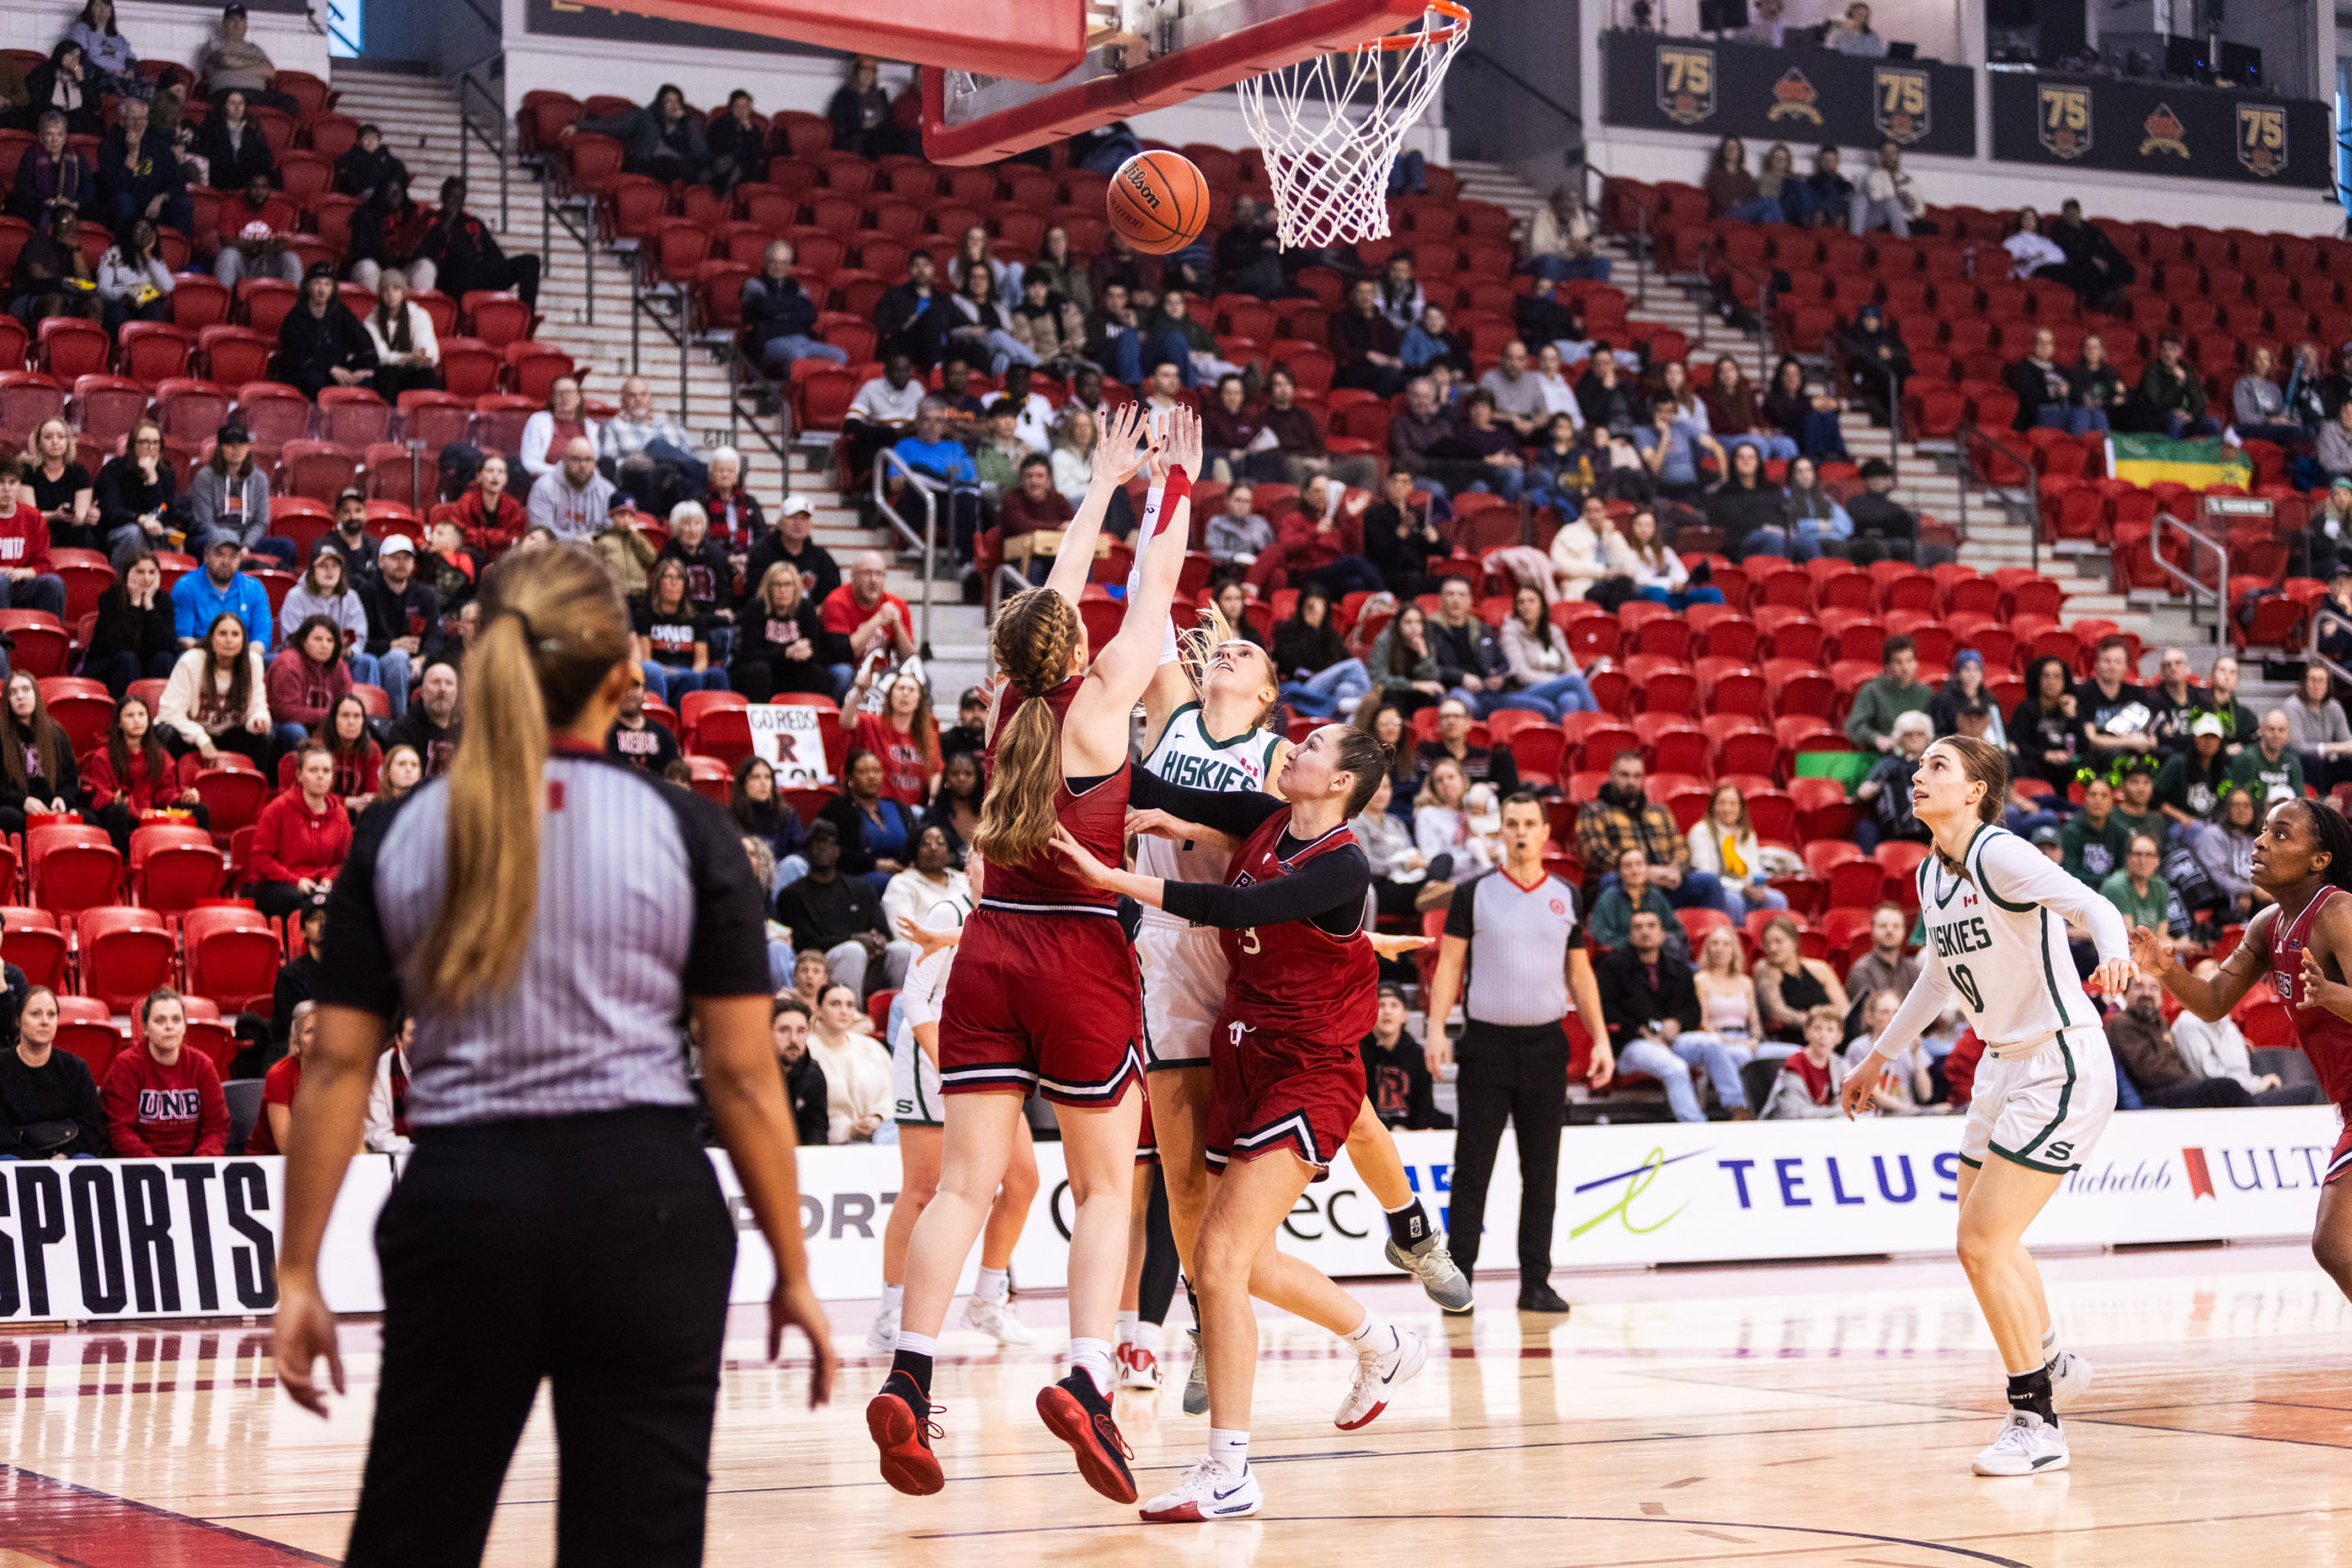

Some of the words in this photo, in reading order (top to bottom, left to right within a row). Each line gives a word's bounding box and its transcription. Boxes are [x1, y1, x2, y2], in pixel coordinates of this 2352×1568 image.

[1661, 52, 1710, 95] 75
[1878, 73, 1924, 115] 75
[2041, 90, 2086, 130] 75
[2240, 109, 2283, 149] 75
[750, 709, 774, 729] GO
[616, 729, 660, 755] REDS
[775, 734, 798, 763] R
[1947, 964, 1984, 1013] 10
[139, 1089, 200, 1120] UNB
[896, 1099, 913, 1114] S
[1377, 1066, 1411, 1110] R
[2044, 1141, 2075, 1161] S
[2221, 1145, 2335, 1190] ULT
[1717, 1152, 1958, 1209] TELUS
